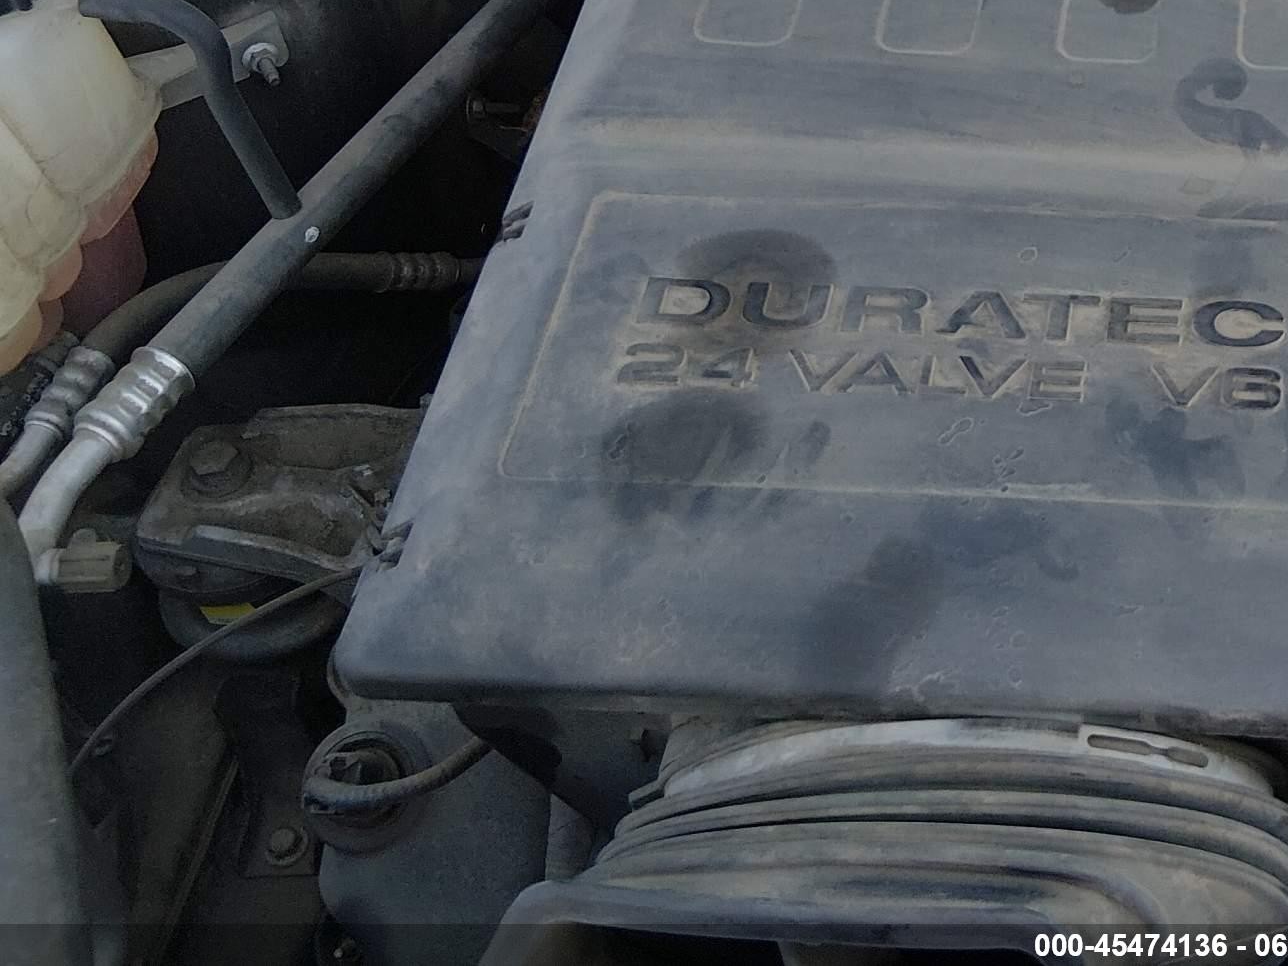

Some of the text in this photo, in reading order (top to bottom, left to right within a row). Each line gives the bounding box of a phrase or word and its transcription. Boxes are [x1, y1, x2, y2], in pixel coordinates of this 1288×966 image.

[632, 275, 1288, 348] DURATEC
[615, 341, 1287, 410] 24 VALVE V6
